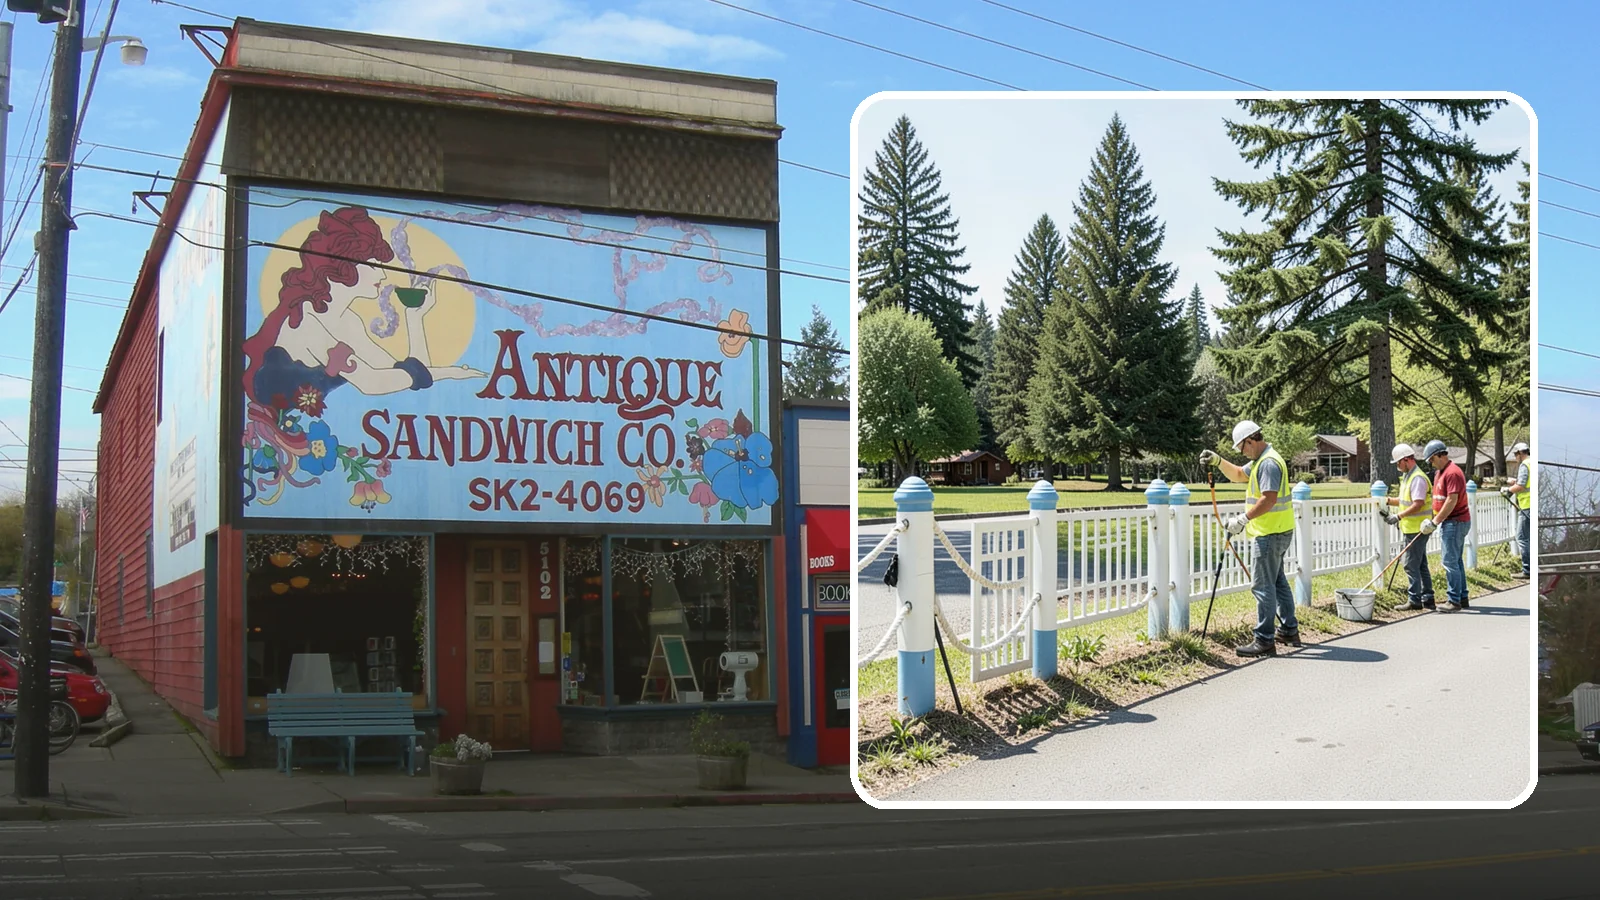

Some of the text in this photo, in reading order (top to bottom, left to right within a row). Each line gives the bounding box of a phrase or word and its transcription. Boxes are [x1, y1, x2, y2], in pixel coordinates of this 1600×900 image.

[476, 329, 724, 420] ANTIQUE
[361, 409, 684, 469] SANDWICH CO.
[468, 477, 646, 512] SK2-4069
[540, 542, 552, 599] 5102
[809, 555, 835, 569] BOOKS
